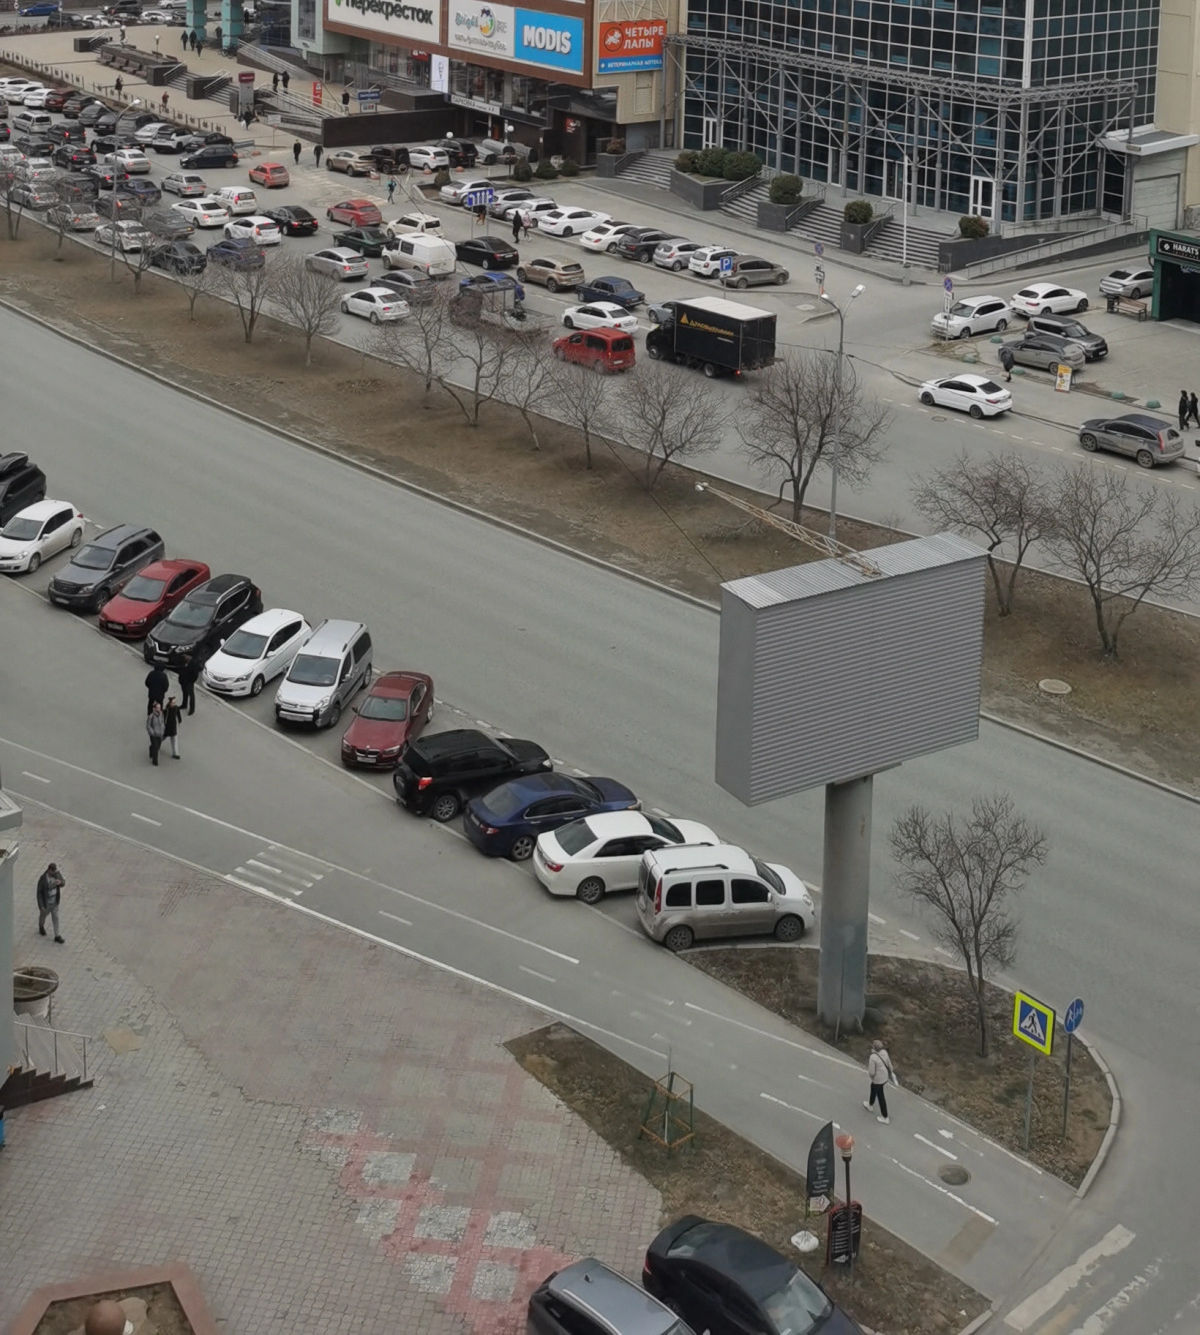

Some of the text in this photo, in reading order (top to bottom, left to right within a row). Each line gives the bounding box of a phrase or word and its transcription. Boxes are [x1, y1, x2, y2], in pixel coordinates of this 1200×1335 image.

[625, 26, 664, 37] ЧЕТЫРЕ
[523, 25, 571, 53] MODIS
[624, 39, 654, 49] ЛАПЫ
